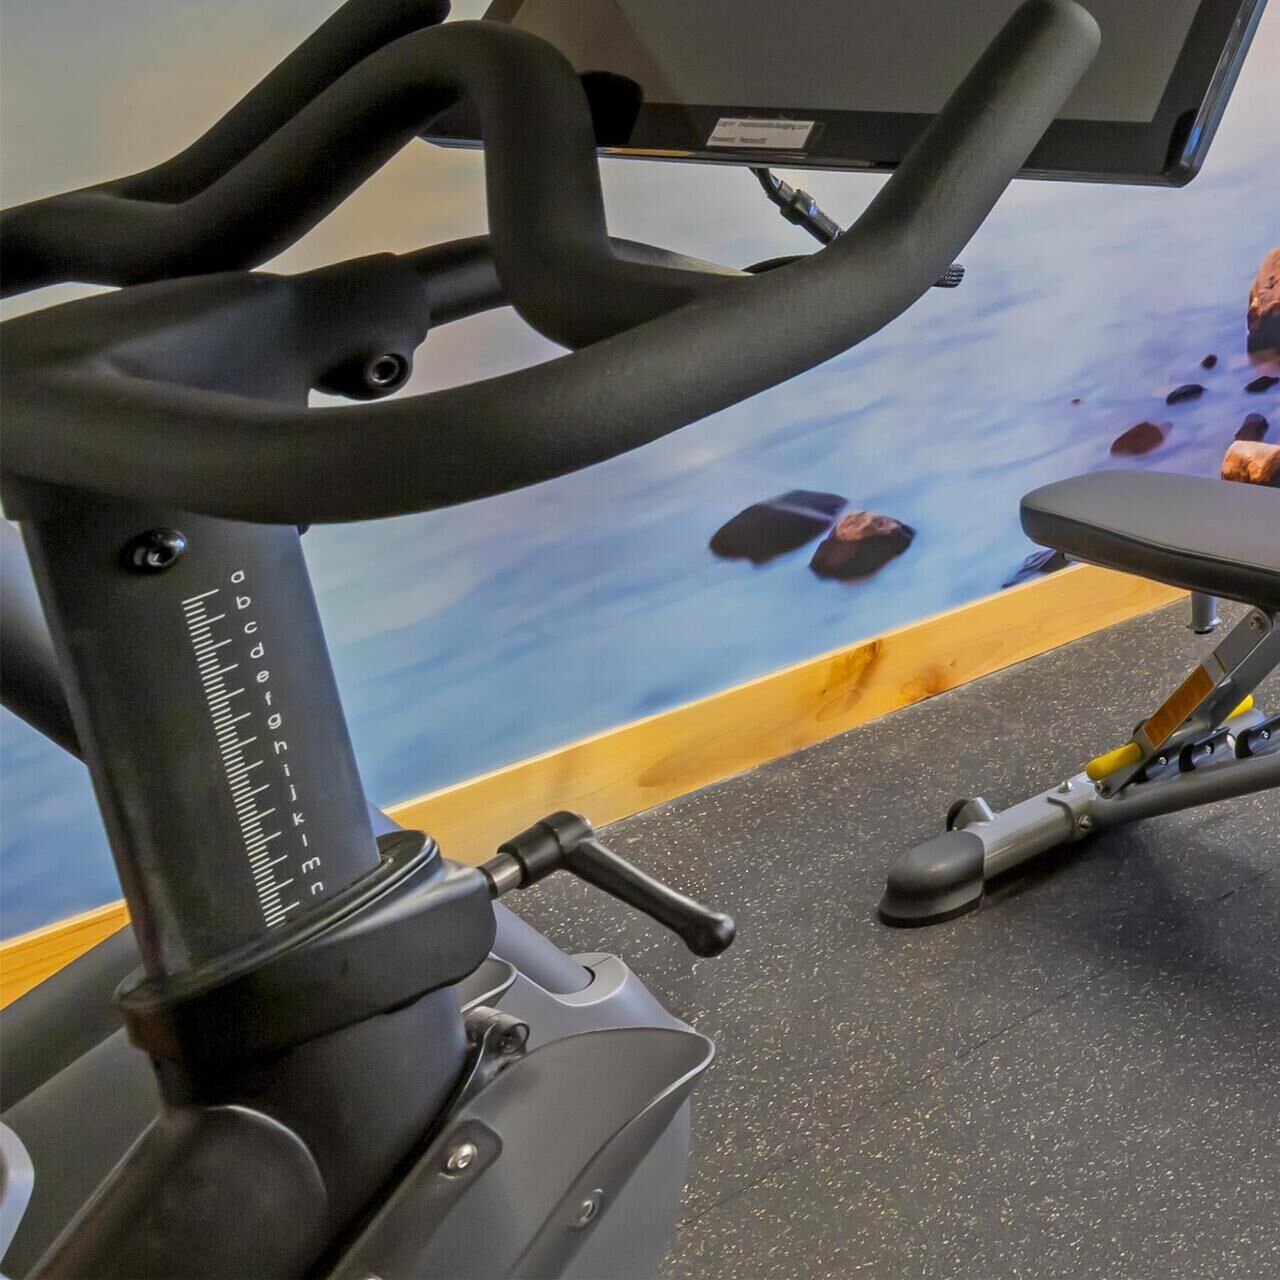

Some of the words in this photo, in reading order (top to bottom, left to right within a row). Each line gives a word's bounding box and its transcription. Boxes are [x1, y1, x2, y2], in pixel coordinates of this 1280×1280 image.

[231, 570, 245, 583] a
[236, 596, 251, 610] b
[244, 621, 258, 634] c
[250, 642, 264, 659] d
[256, 670, 270, 683] e
[267, 713, 282, 730] g
[302, 856, 321, 874] m
